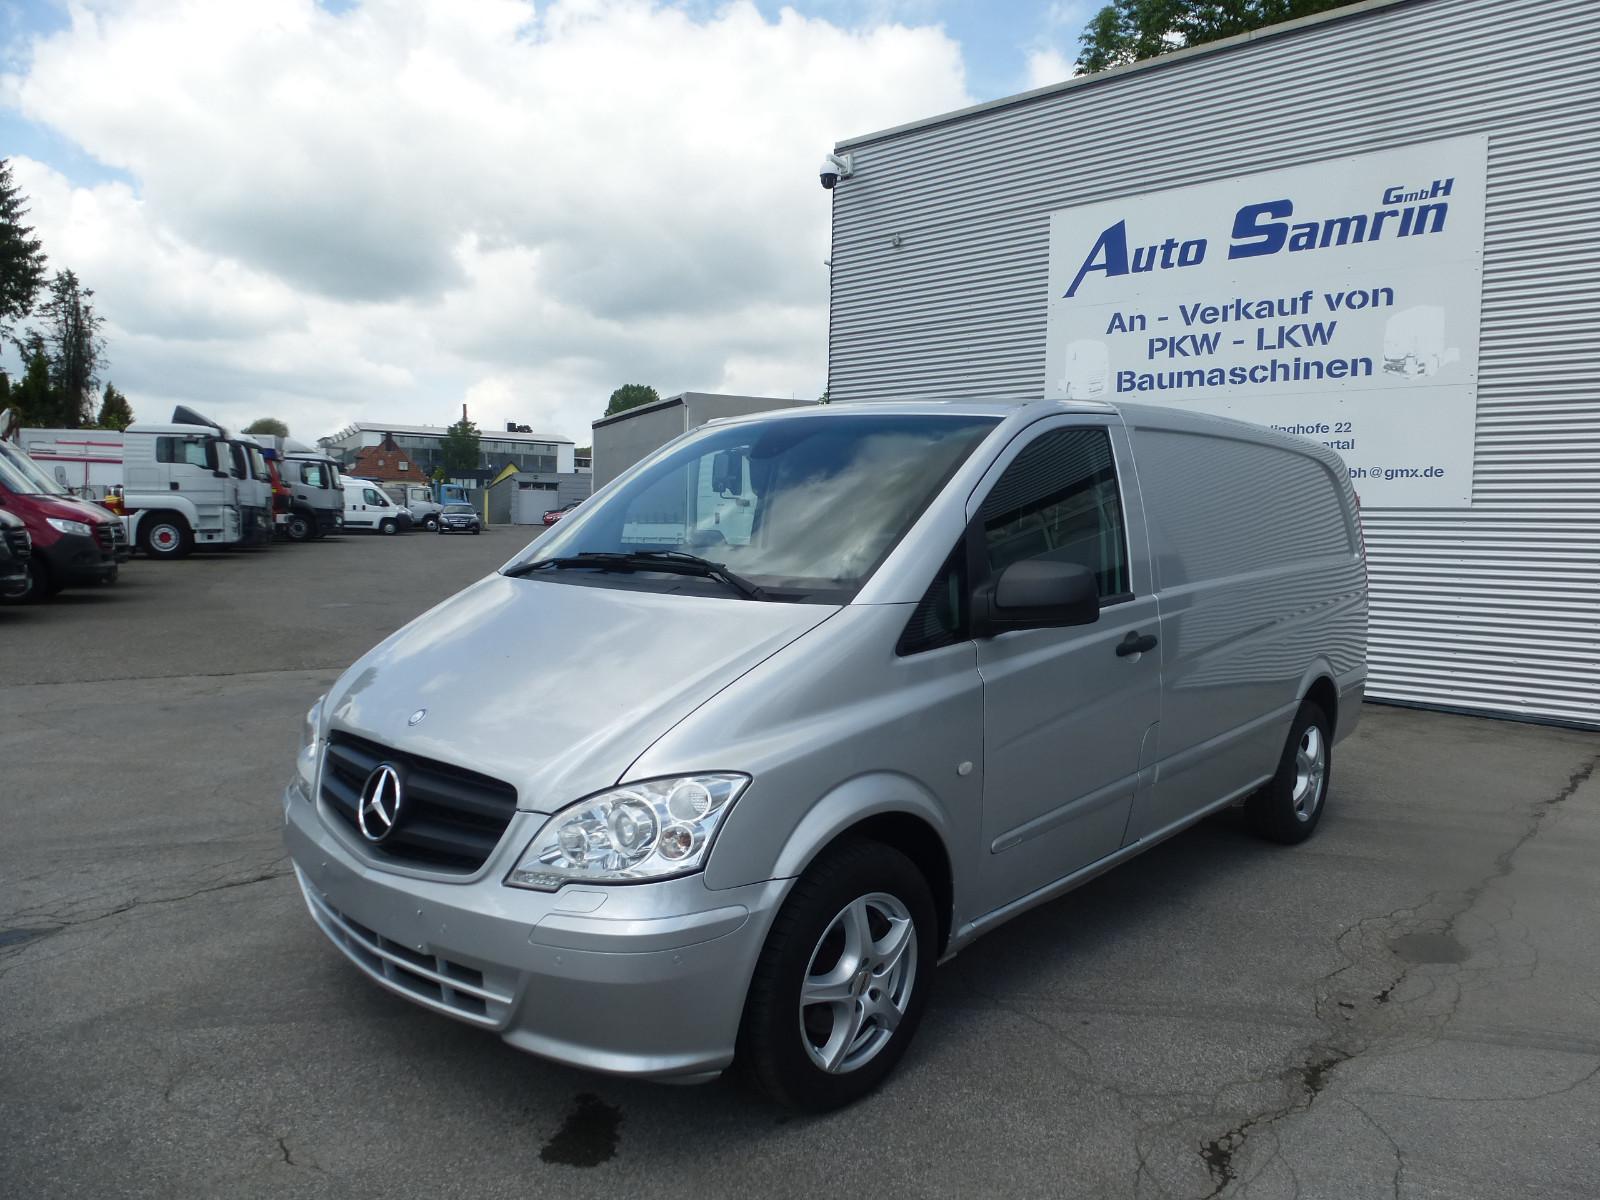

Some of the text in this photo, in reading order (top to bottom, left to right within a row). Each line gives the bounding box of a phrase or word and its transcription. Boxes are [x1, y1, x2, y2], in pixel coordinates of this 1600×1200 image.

[1382, 177, 1455, 206] GmbH
[1062, 198, 1449, 298] Auto Samrin
[1105, 312, 1147, 335] An
[1178, 290, 1314, 326] Verkauf
[1323, 287, 1394, 312] von
[1148, 331, 1222, 360] PKW
[1256, 320, 1338, 351] LKW
[1116, 357, 1373, 393] Baumaschinen
[1334, 422, 1352, 433] 22
